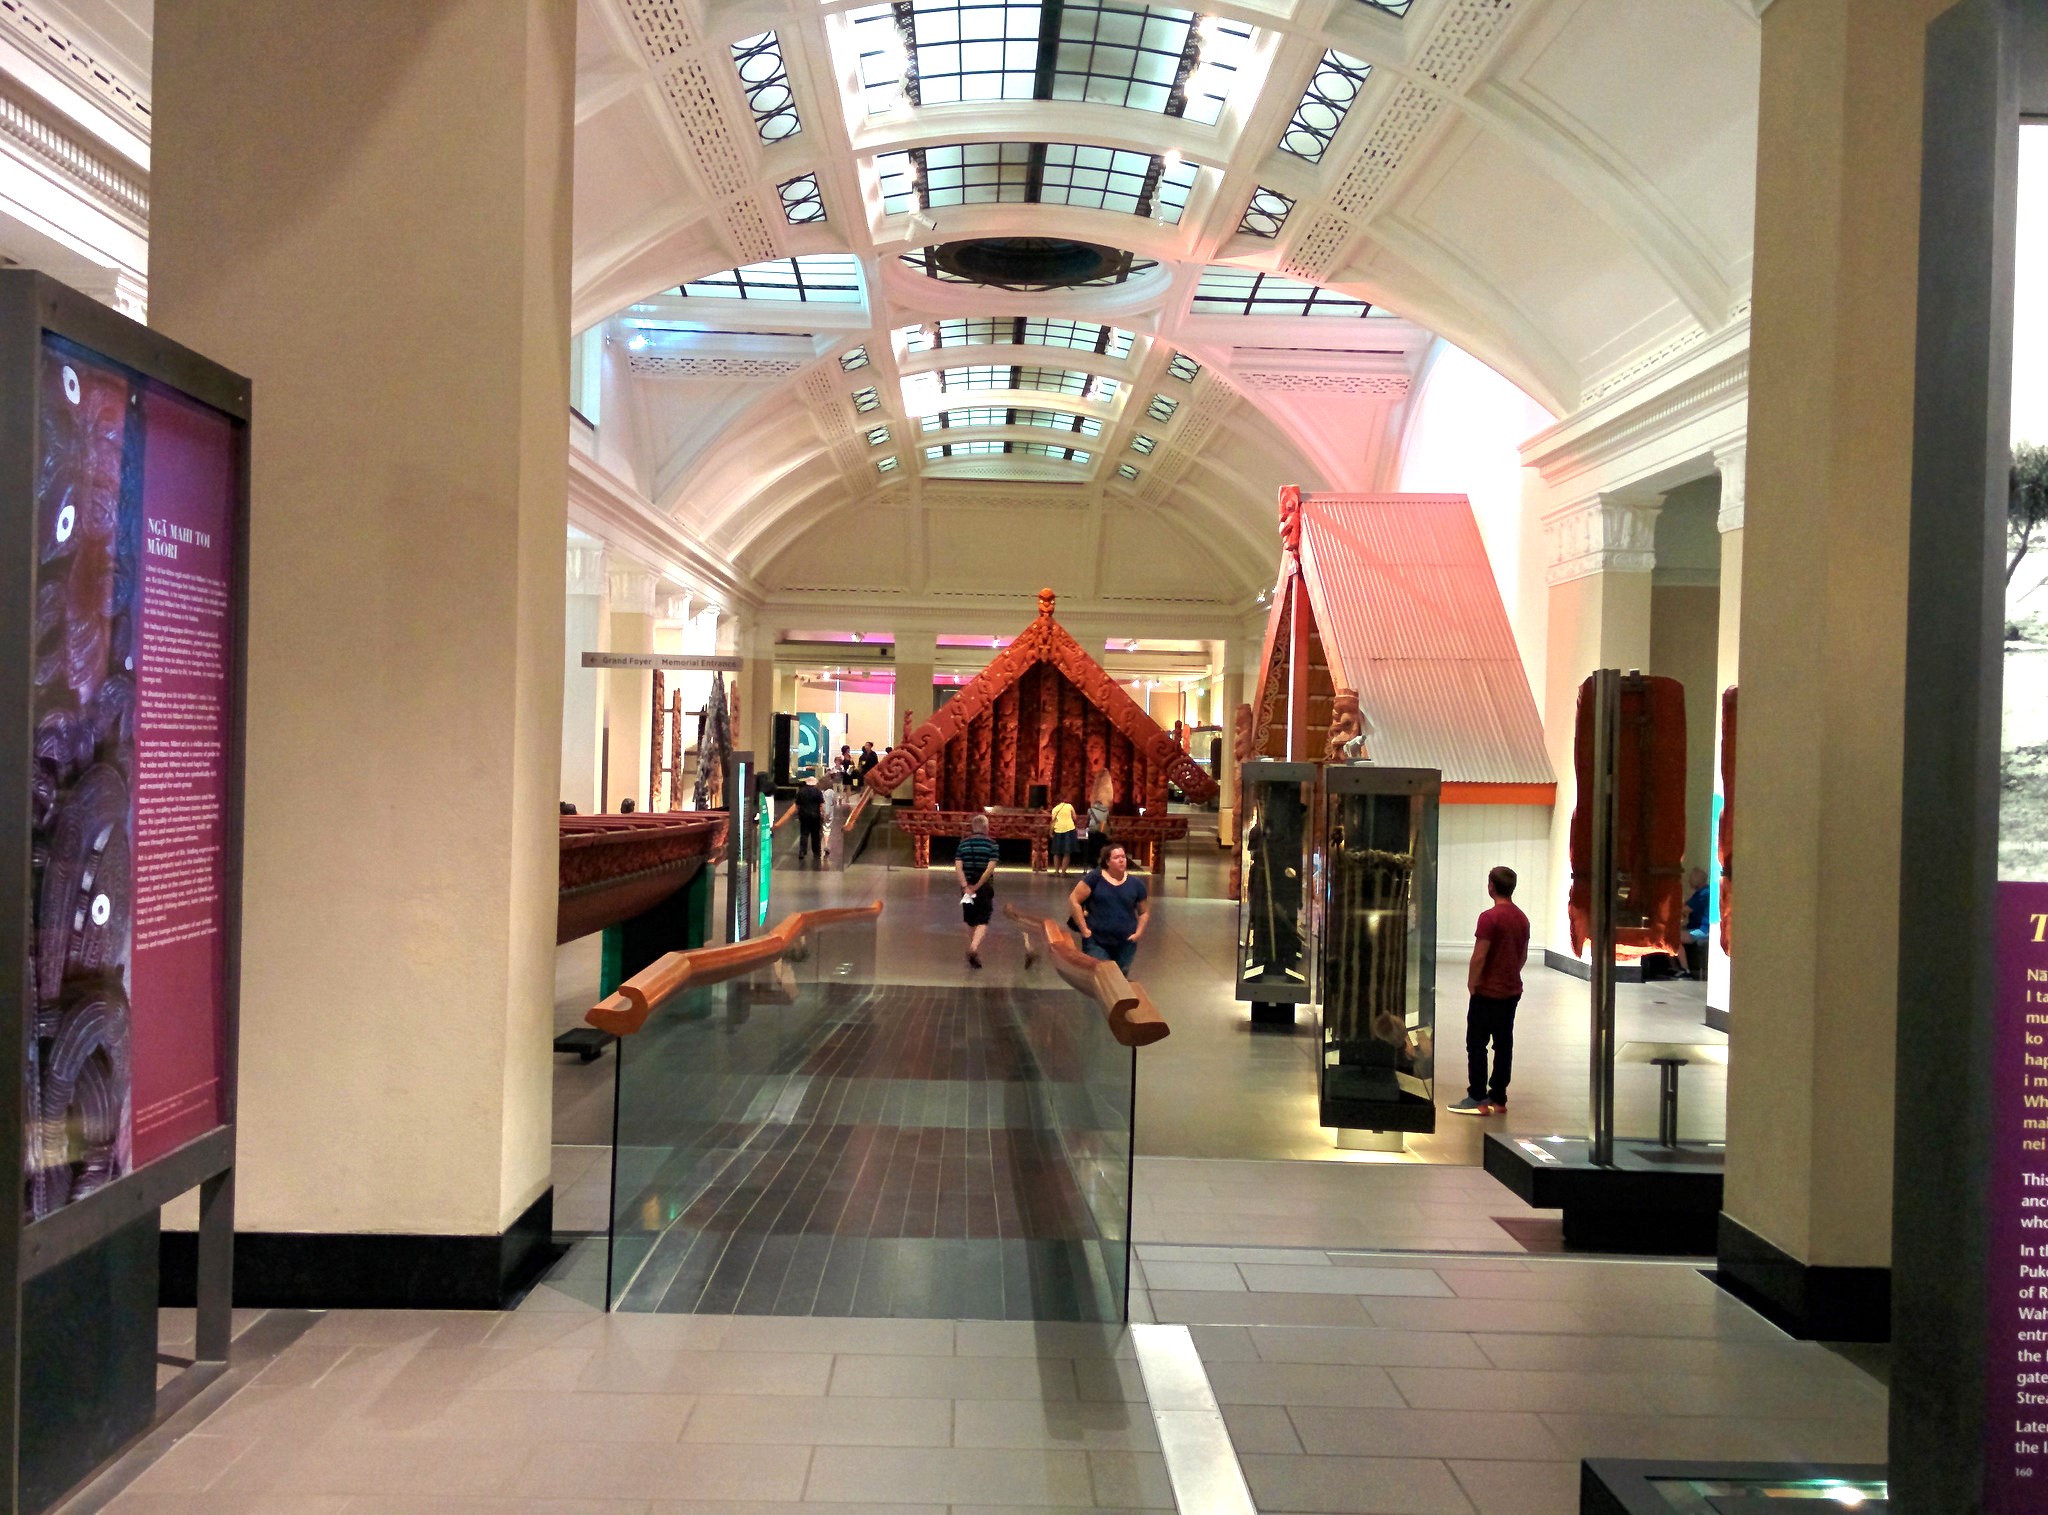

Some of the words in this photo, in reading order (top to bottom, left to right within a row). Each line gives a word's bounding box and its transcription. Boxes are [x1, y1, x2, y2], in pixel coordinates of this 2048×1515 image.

[148, 517, 167, 537] NGĀ
[170, 524, 193, 544] MAHI
[195, 531, 211, 548] TOI
[147, 538, 178, 559] MĀORI
[602, 656, 627, 665] Grand
[629, 657, 652, 666] Foyer
[661, 658, 699, 668] Memorial
[701, 659, 737, 668] Entrance
[2025, 1031, 2043, 1045] ko
[2024, 1074, 2029, 1086] i
[2023, 1137, 2046, 1150] nei
[2020, 1244, 2035, 1256] In
[2019, 1286, 2035, 1299] of
[2017, 1349, 2042, 1362] the
[2015, 1441, 2039, 1453] the
[2015, 1467, 2033, 1477] 160
